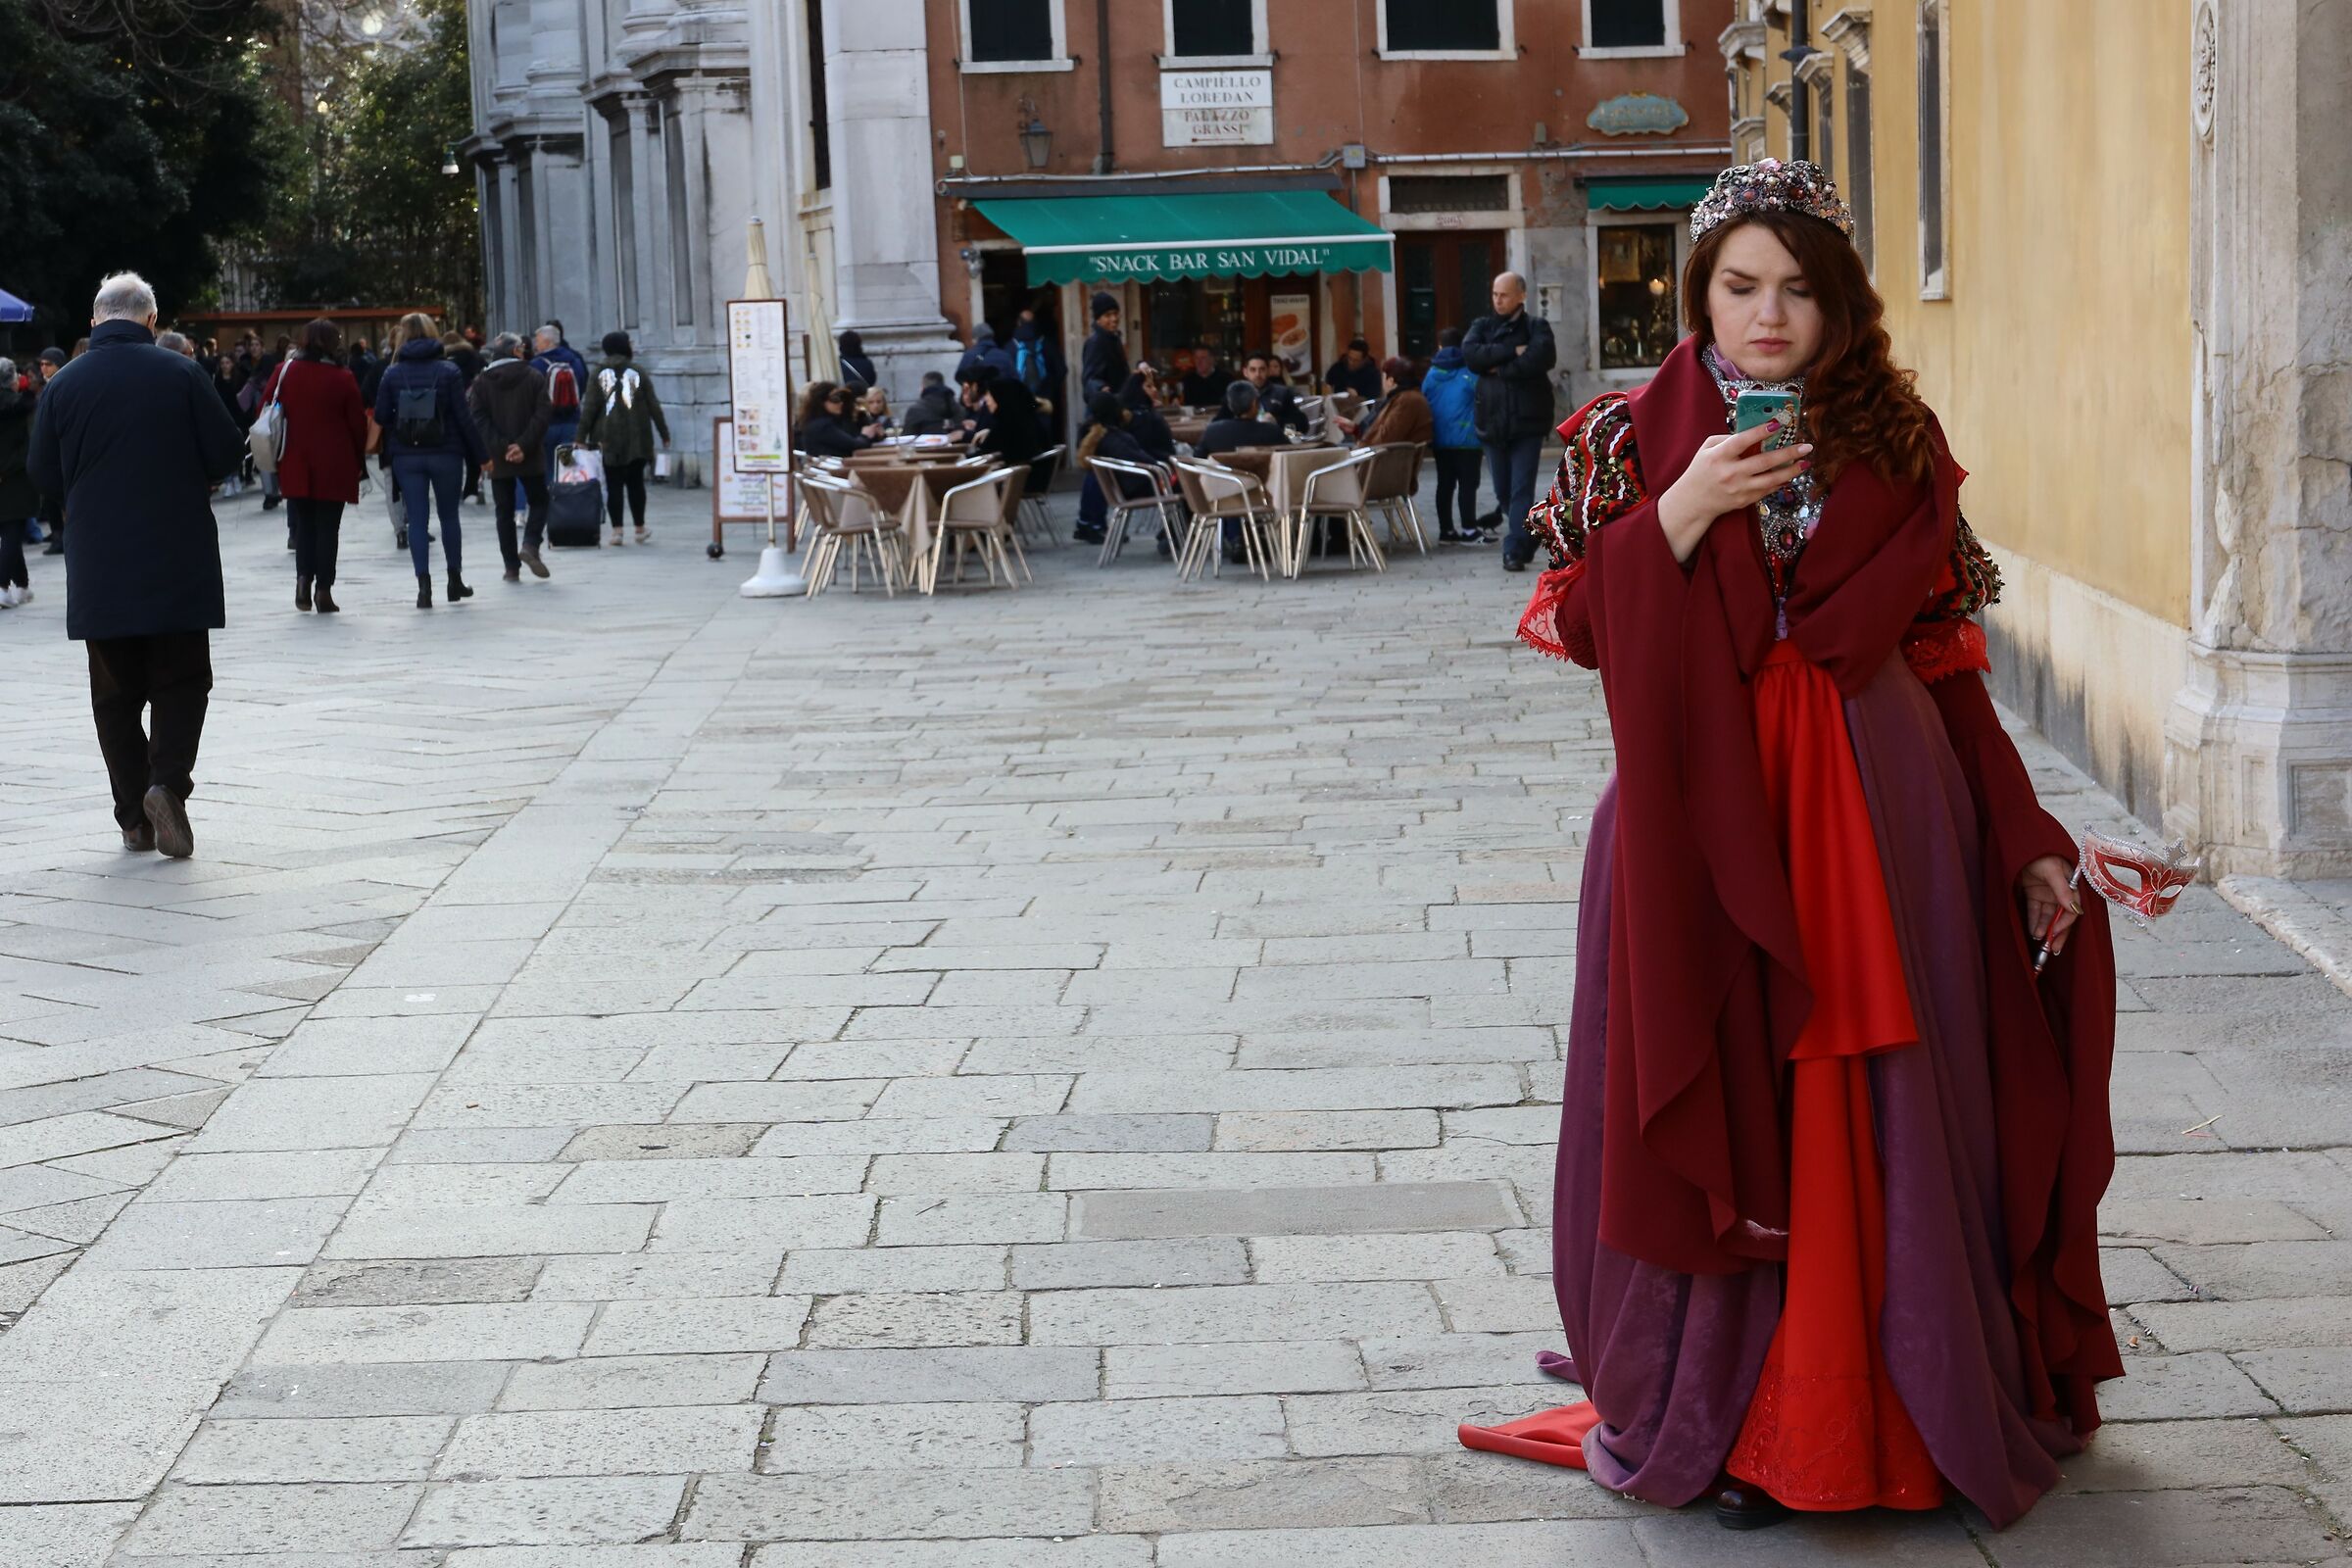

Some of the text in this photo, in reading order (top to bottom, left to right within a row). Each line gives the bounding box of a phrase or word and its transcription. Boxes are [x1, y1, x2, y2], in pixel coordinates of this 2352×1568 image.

[1174, 76, 1261, 88] CAMPIELLO
[1181, 91, 1253, 104] LOREDAN
[1185, 110, 1250, 122] PALAZZO
[1193, 124, 1243, 135] GRASSI
[1169, 252, 1209, 270] BAR
[1216, 250, 1255, 268] SAN
